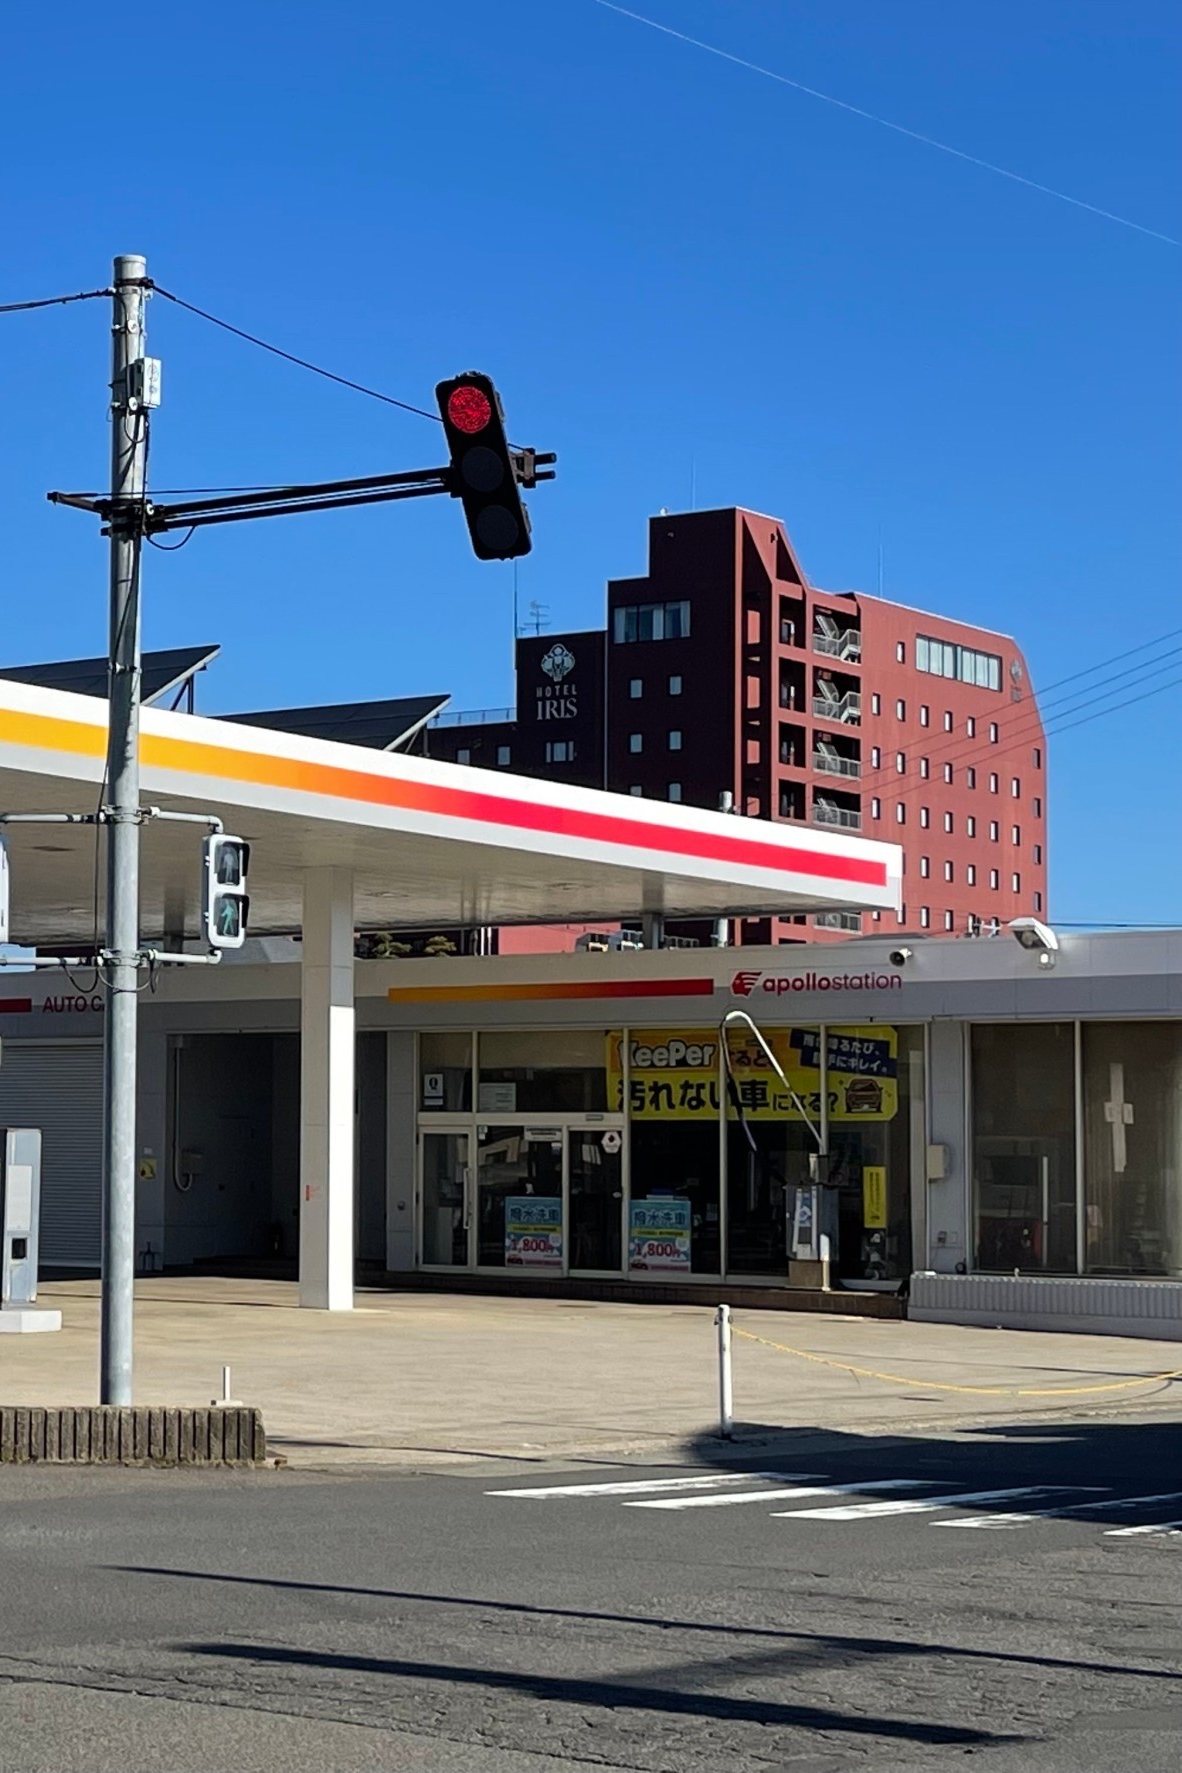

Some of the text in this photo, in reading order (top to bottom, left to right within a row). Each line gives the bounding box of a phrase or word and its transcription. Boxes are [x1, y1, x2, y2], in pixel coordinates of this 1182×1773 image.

[536, 684, 577, 697] HOTEL
[537, 697, 578, 720] IRIS
[762, 972, 902, 996] apollostation
[42, 995, 87, 1013] AUTO
